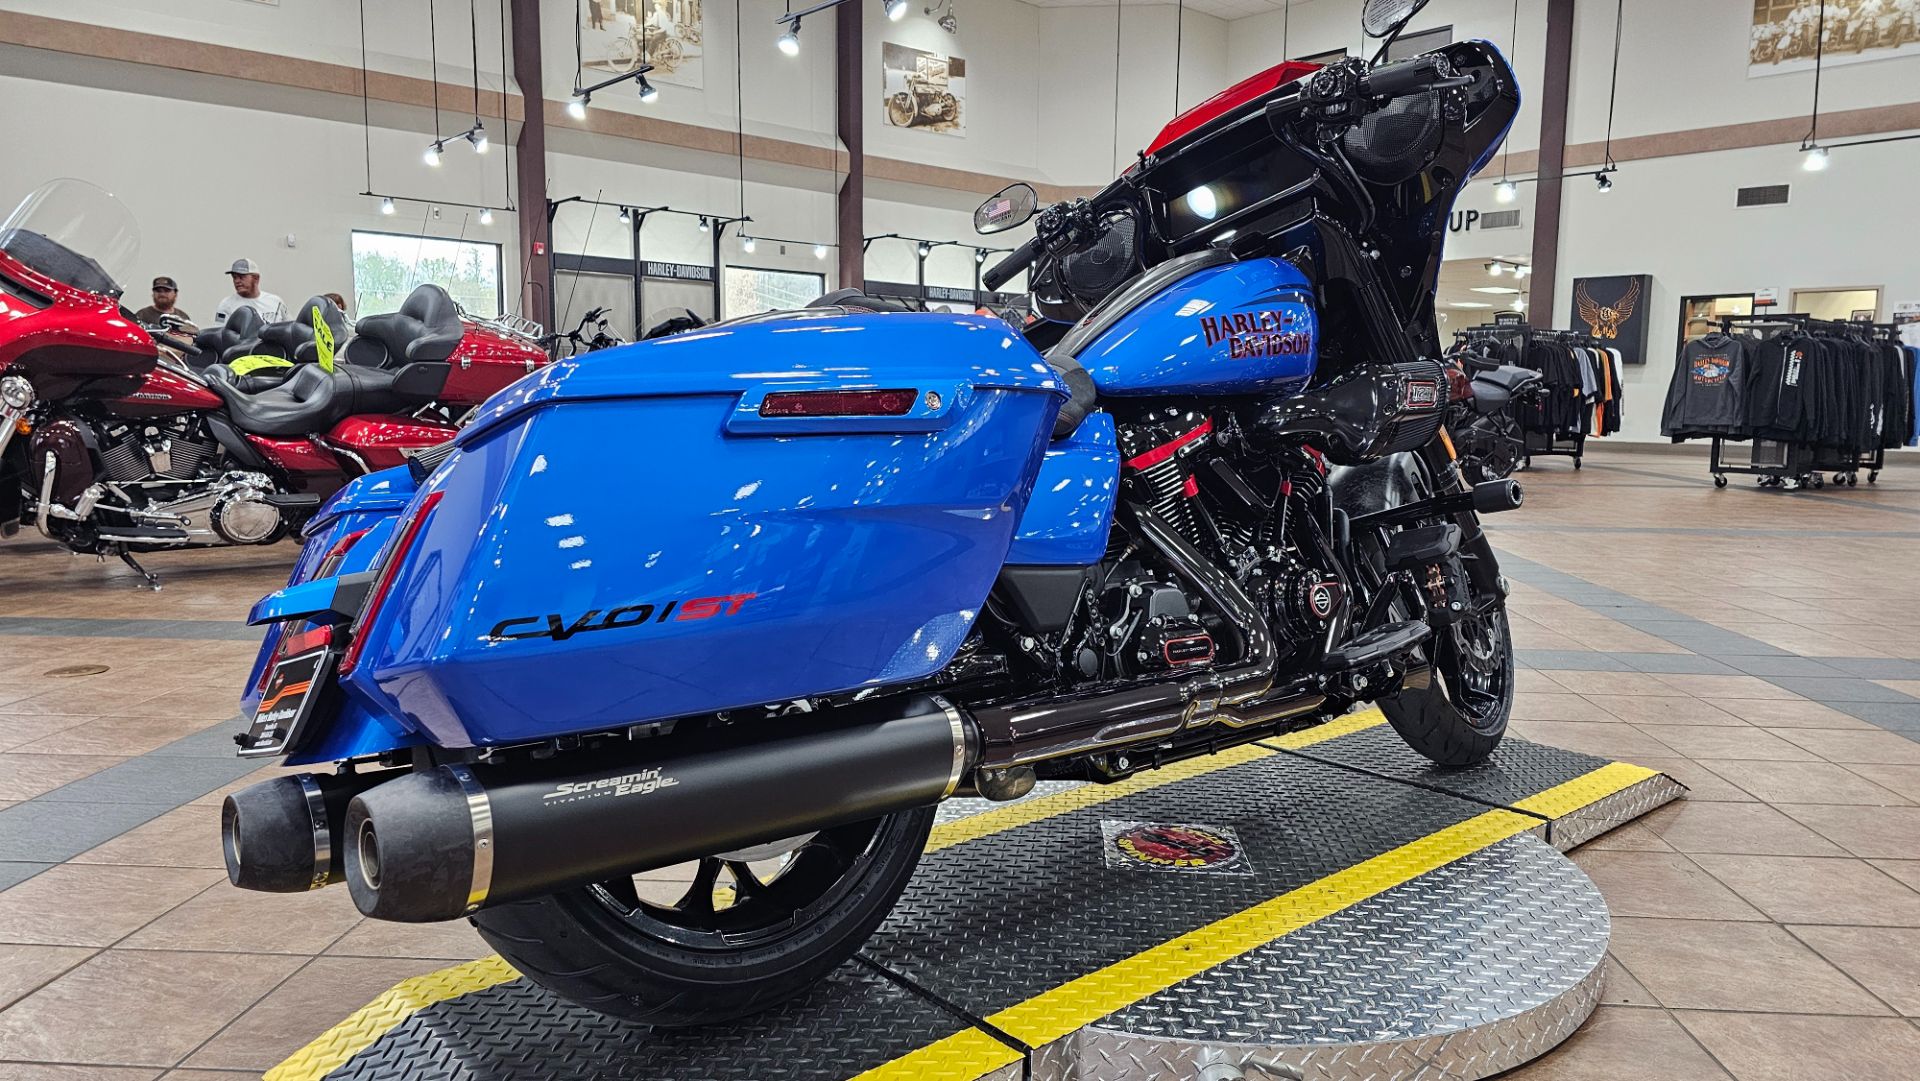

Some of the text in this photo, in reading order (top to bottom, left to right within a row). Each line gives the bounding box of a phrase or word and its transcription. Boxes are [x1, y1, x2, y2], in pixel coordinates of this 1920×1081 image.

[1449, 210, 1479, 232] UP
[647, 262, 711, 280] HARLEY-DAVIDSON
[928, 287, 974, 301] HARLEY-DAVIDSON
[1199, 310, 1294, 348] HARLEY-
[1229, 333, 1311, 359] DAVIDSON
[615, 776, 680, 797] Eagle
